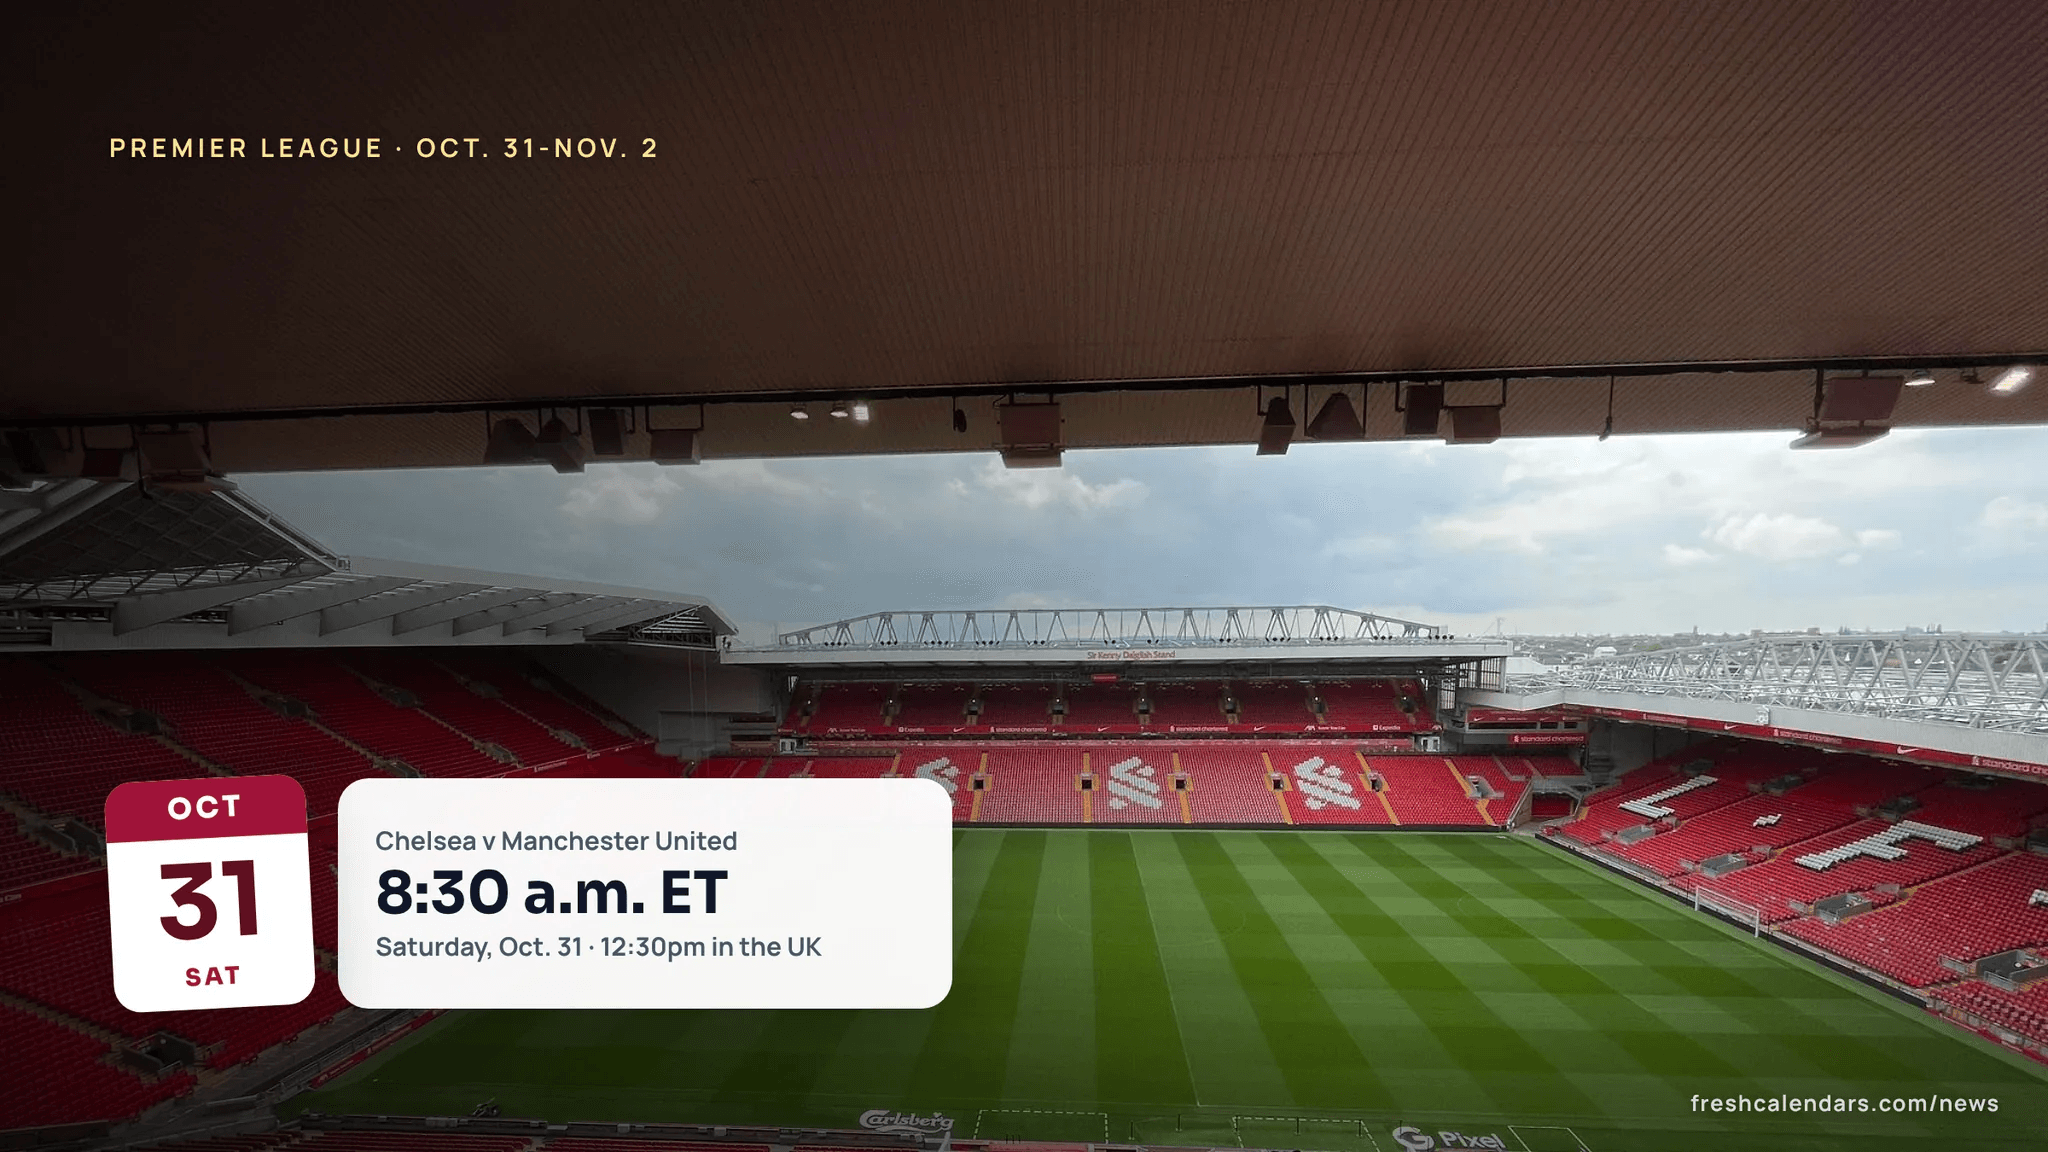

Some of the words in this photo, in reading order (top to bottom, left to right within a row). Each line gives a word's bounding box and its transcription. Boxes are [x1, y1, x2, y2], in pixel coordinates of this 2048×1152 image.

[1099, 651, 1121, 660] Kenny
[1153, 650, 1176, 659] Stand
[1982, 758, 2030, 773] standard
[859, 1109, 955, 1133] Carlsberg
[1438, 1131, 1506, 1149] Pixel
